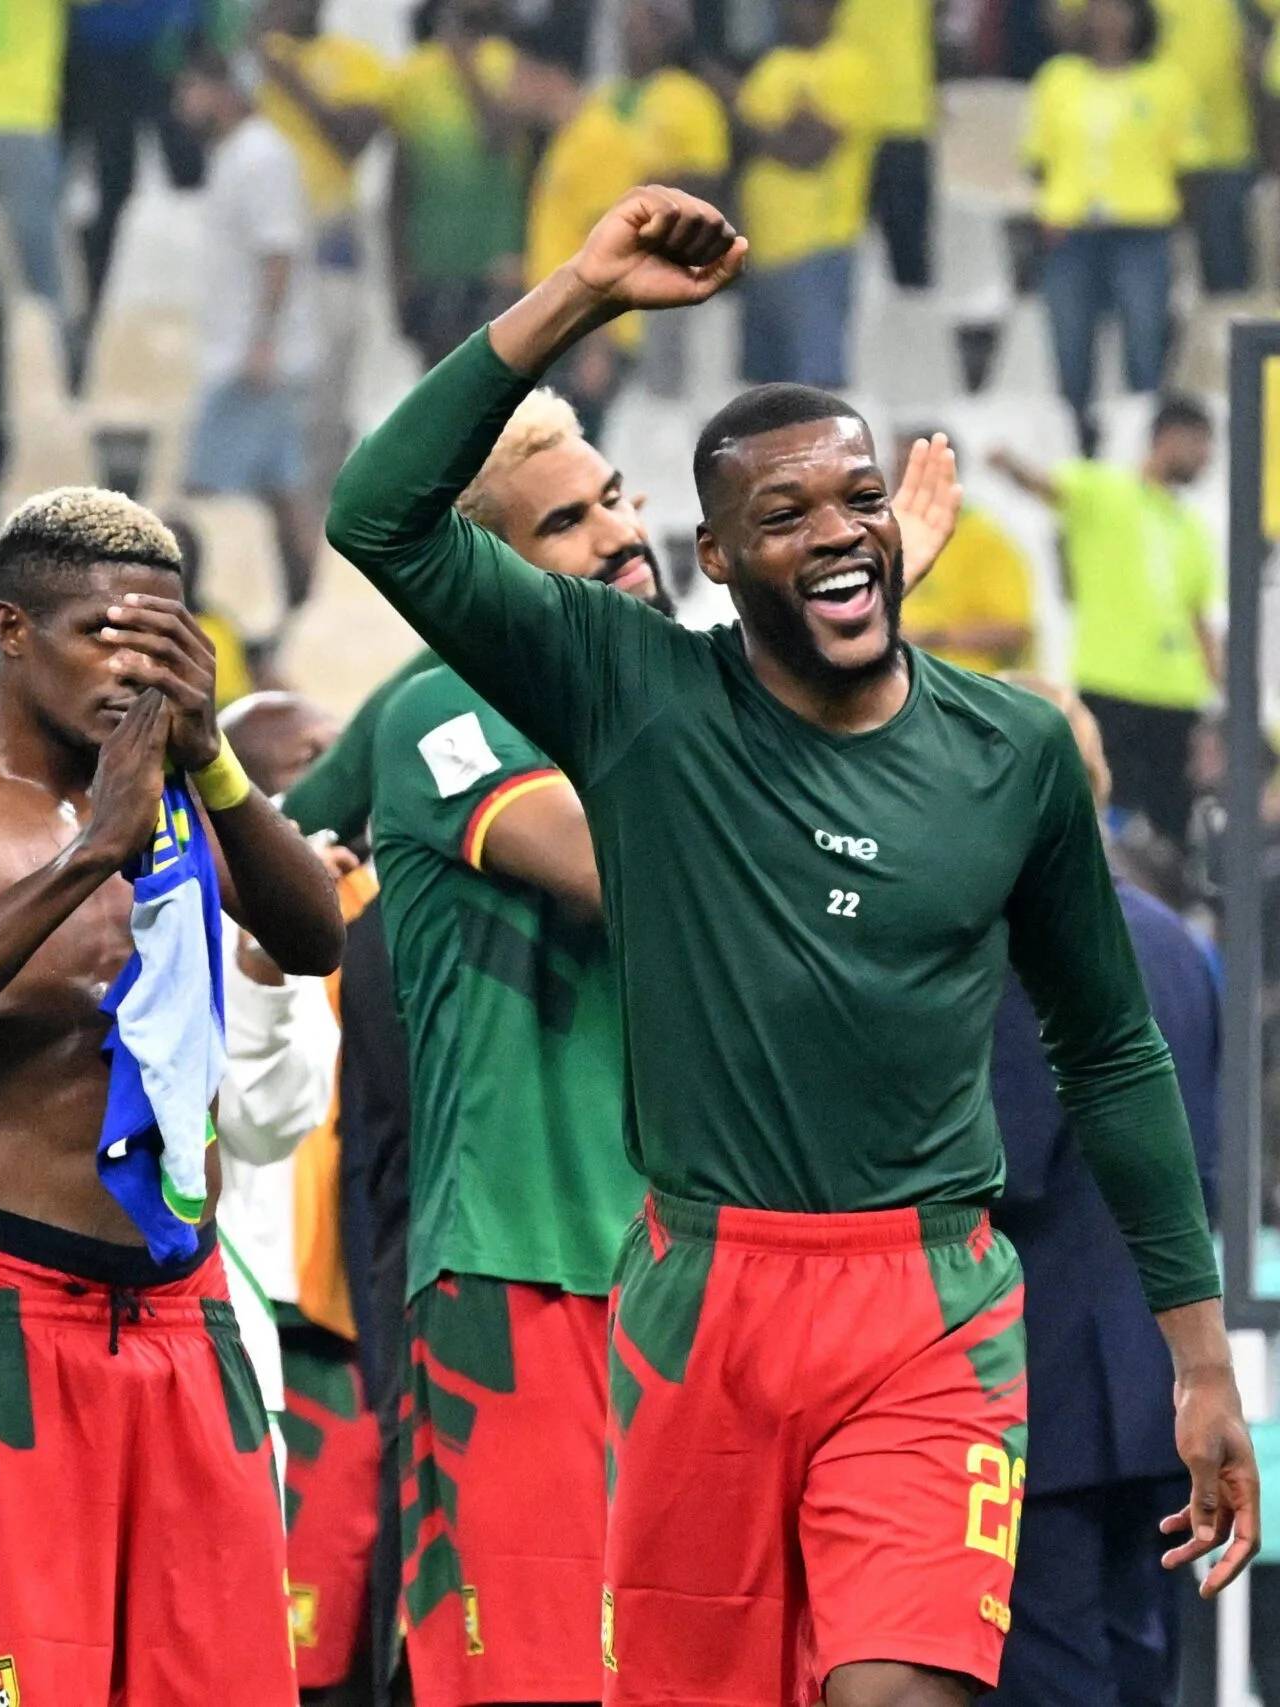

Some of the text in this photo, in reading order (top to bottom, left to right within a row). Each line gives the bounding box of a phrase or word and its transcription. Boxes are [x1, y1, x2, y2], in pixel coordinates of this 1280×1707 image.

[814, 829, 878, 861] one
[826, 889, 860, 918] 22
[964, 1443, 1026, 1569] 22
